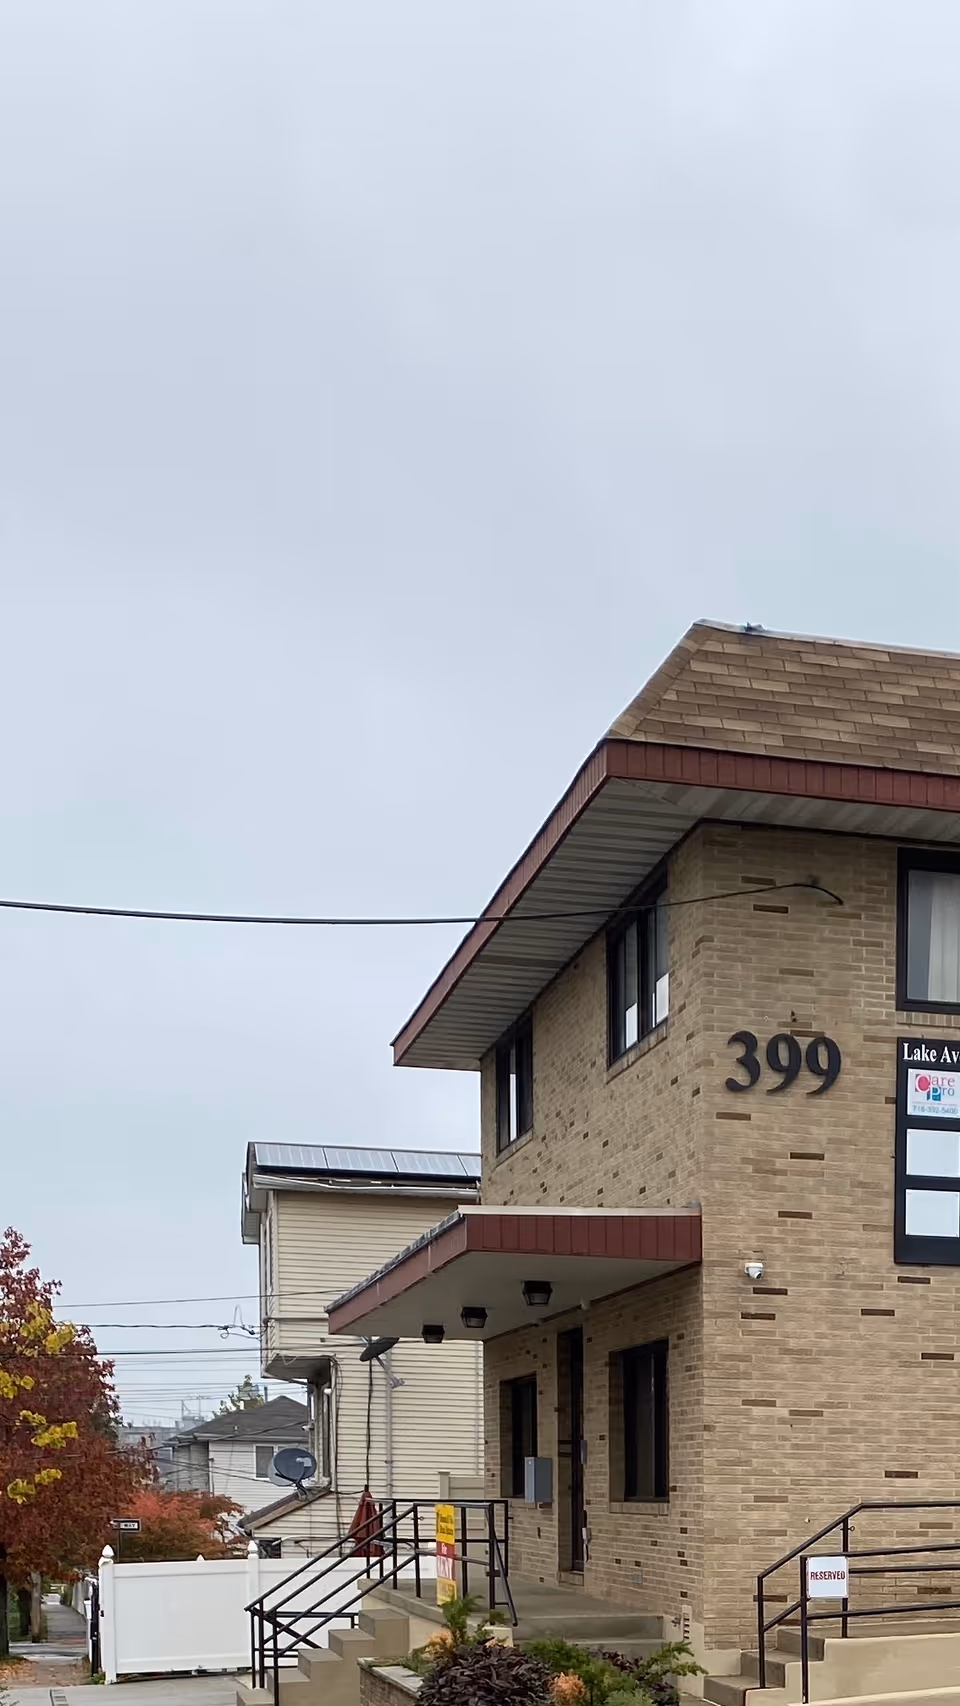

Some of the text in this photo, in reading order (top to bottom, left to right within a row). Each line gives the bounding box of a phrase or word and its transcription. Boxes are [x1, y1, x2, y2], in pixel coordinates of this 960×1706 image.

[903, 1042, 937, 1062] Lake
[725, 1030, 841, 1095] 399
[915, 1073, 956, 1092] Care
[926, 1086, 955, 1102] Pro
[810, 1570, 846, 1580] RESERVED
